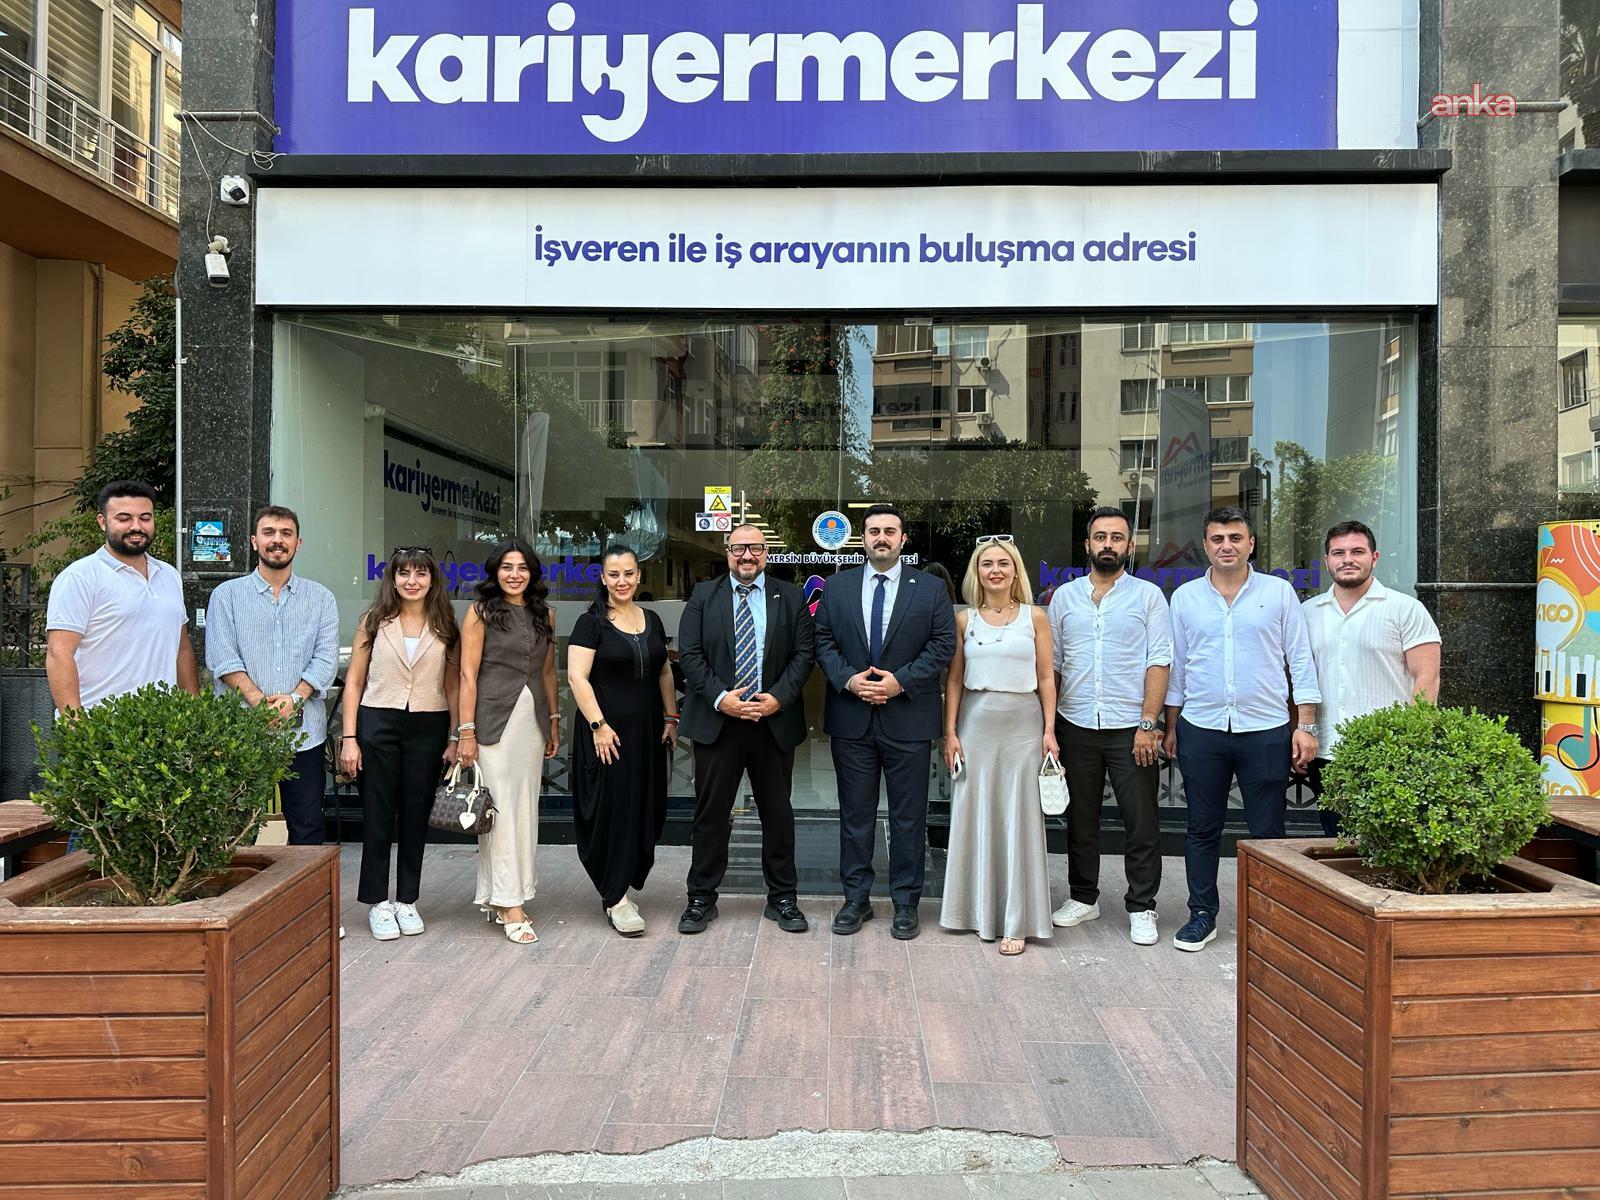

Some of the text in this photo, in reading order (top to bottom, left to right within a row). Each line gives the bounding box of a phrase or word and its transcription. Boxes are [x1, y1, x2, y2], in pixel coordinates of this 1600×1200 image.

[347, 0, 1258, 142] kariyermerkezi
[535, 225, 1197, 269] İşveren ile iş arayanın buluşma adresi
[383, 448, 501, 515] kariyermerkezi
[767, 551, 803, 564] MERSİN
[803, 551, 866, 566] BÜYÜKŞEHİR
